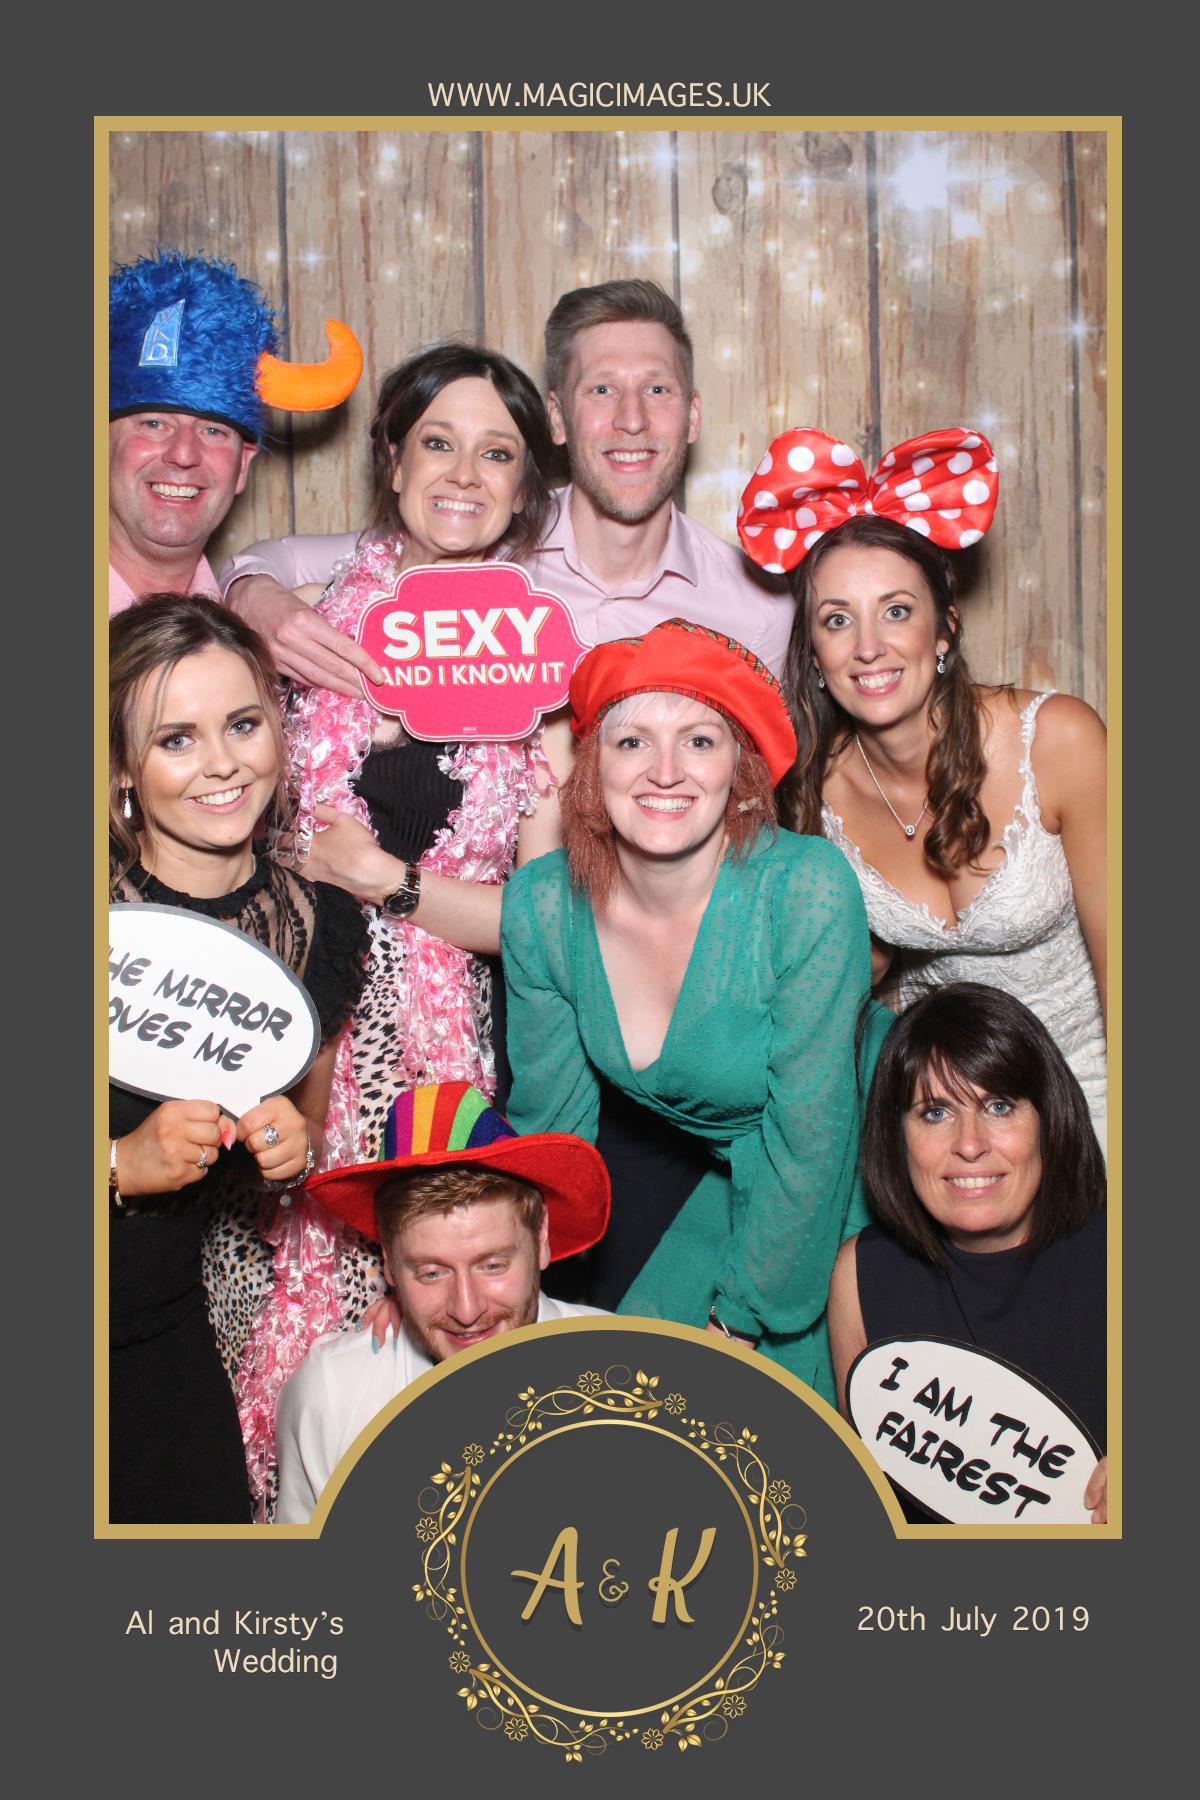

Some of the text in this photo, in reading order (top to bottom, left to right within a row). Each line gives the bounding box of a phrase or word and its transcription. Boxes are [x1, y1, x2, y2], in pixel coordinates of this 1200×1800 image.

[382, 606, 552, 661] SEXY
[381, 661, 566, 687] AND I KNOW IT
[109, 944, 293, 1042] HE MIRROR
[193, 1031, 253, 1072] ME
[879, 1356, 1076, 1479] I AM THE
[876, 1411, 1051, 1519] FAIREST
